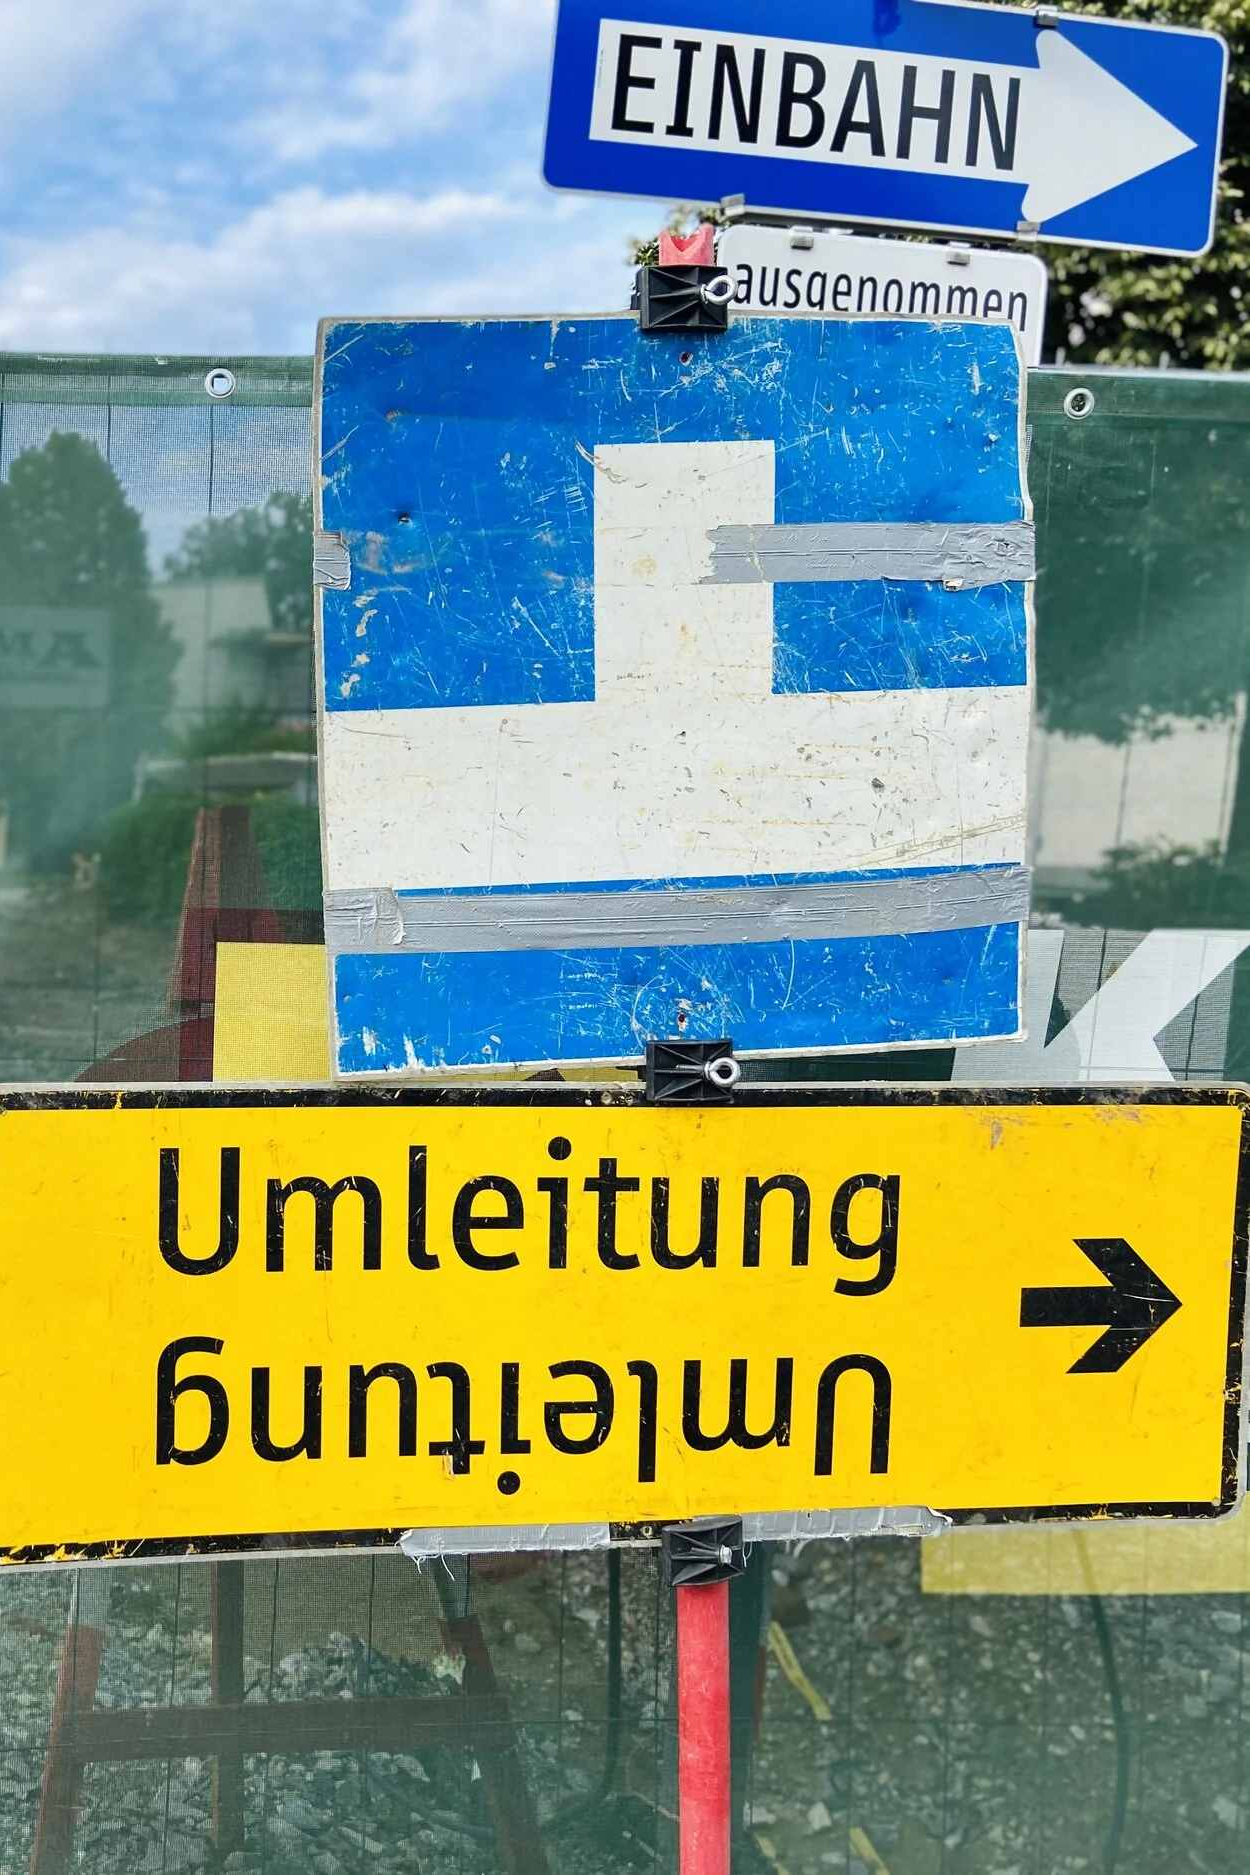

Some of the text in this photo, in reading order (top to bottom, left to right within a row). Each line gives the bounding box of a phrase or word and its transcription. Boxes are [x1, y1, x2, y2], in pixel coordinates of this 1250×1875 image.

[611, 33, 1021, 172] EINBAHN
[158, 1136, 900, 1296] Umleitung
[156, 1336, 893, 1495] Umleitung
